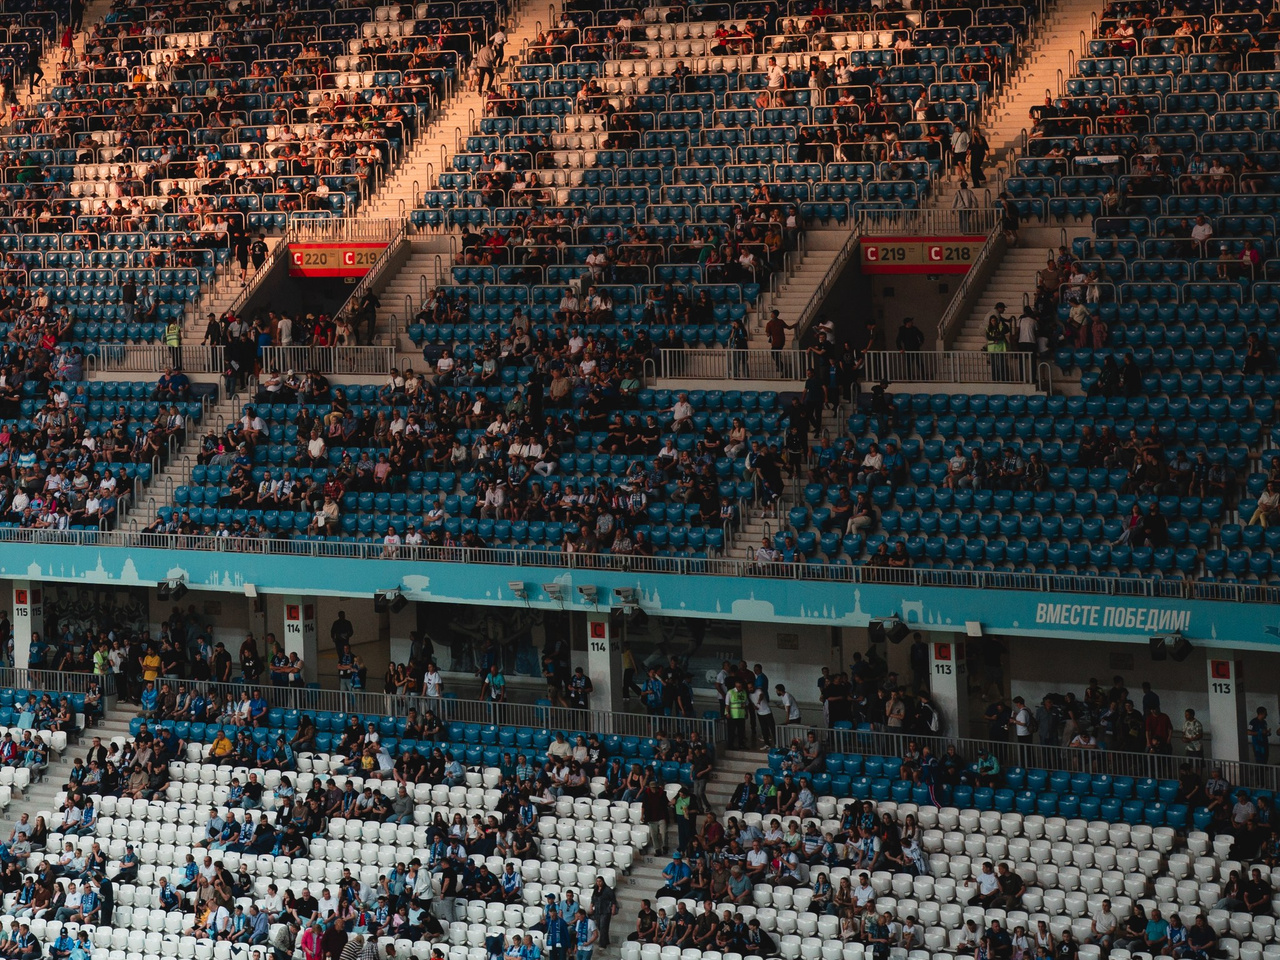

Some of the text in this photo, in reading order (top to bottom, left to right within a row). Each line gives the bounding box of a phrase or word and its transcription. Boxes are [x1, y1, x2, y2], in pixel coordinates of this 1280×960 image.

[305, 253, 328, 265] 220
[356, 252, 377, 265] 219
[881, 247, 906, 261] 219
[945, 247, 971, 261] 218
[16, 608, 28, 616] 115
[32, 607, 42, 616] 115
[1035, 602, 1191, 632] ВМЕСТЕ ПОБЕДИМ!
[287, 624, 300, 633] 114
[591, 642, 606, 651] 114
[935, 664, 951, 674] 113
[1212, 683, 1231, 694] 113
